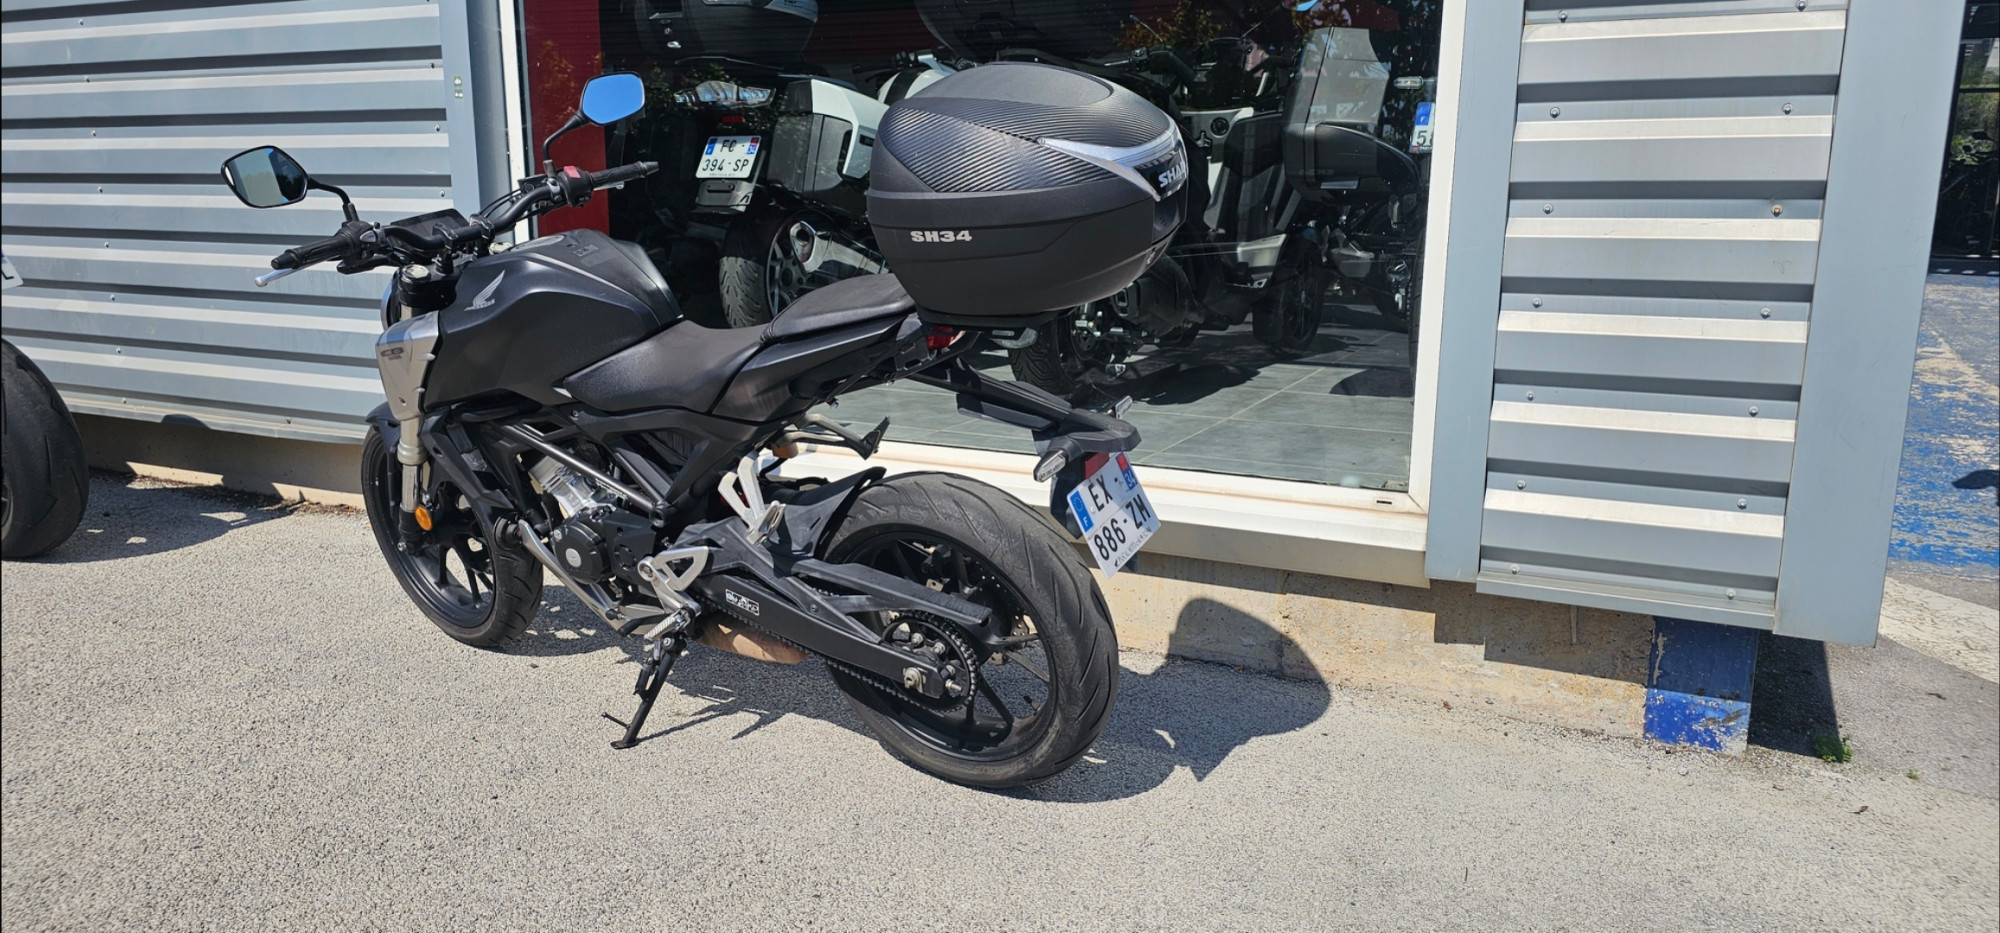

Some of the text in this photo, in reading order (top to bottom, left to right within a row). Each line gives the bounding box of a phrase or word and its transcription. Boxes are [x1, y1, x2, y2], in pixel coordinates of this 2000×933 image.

[910, 230, 973, 243] SH34
[1124, 470, 1137, 488] 34
[1082, 516, 1089, 527] F
